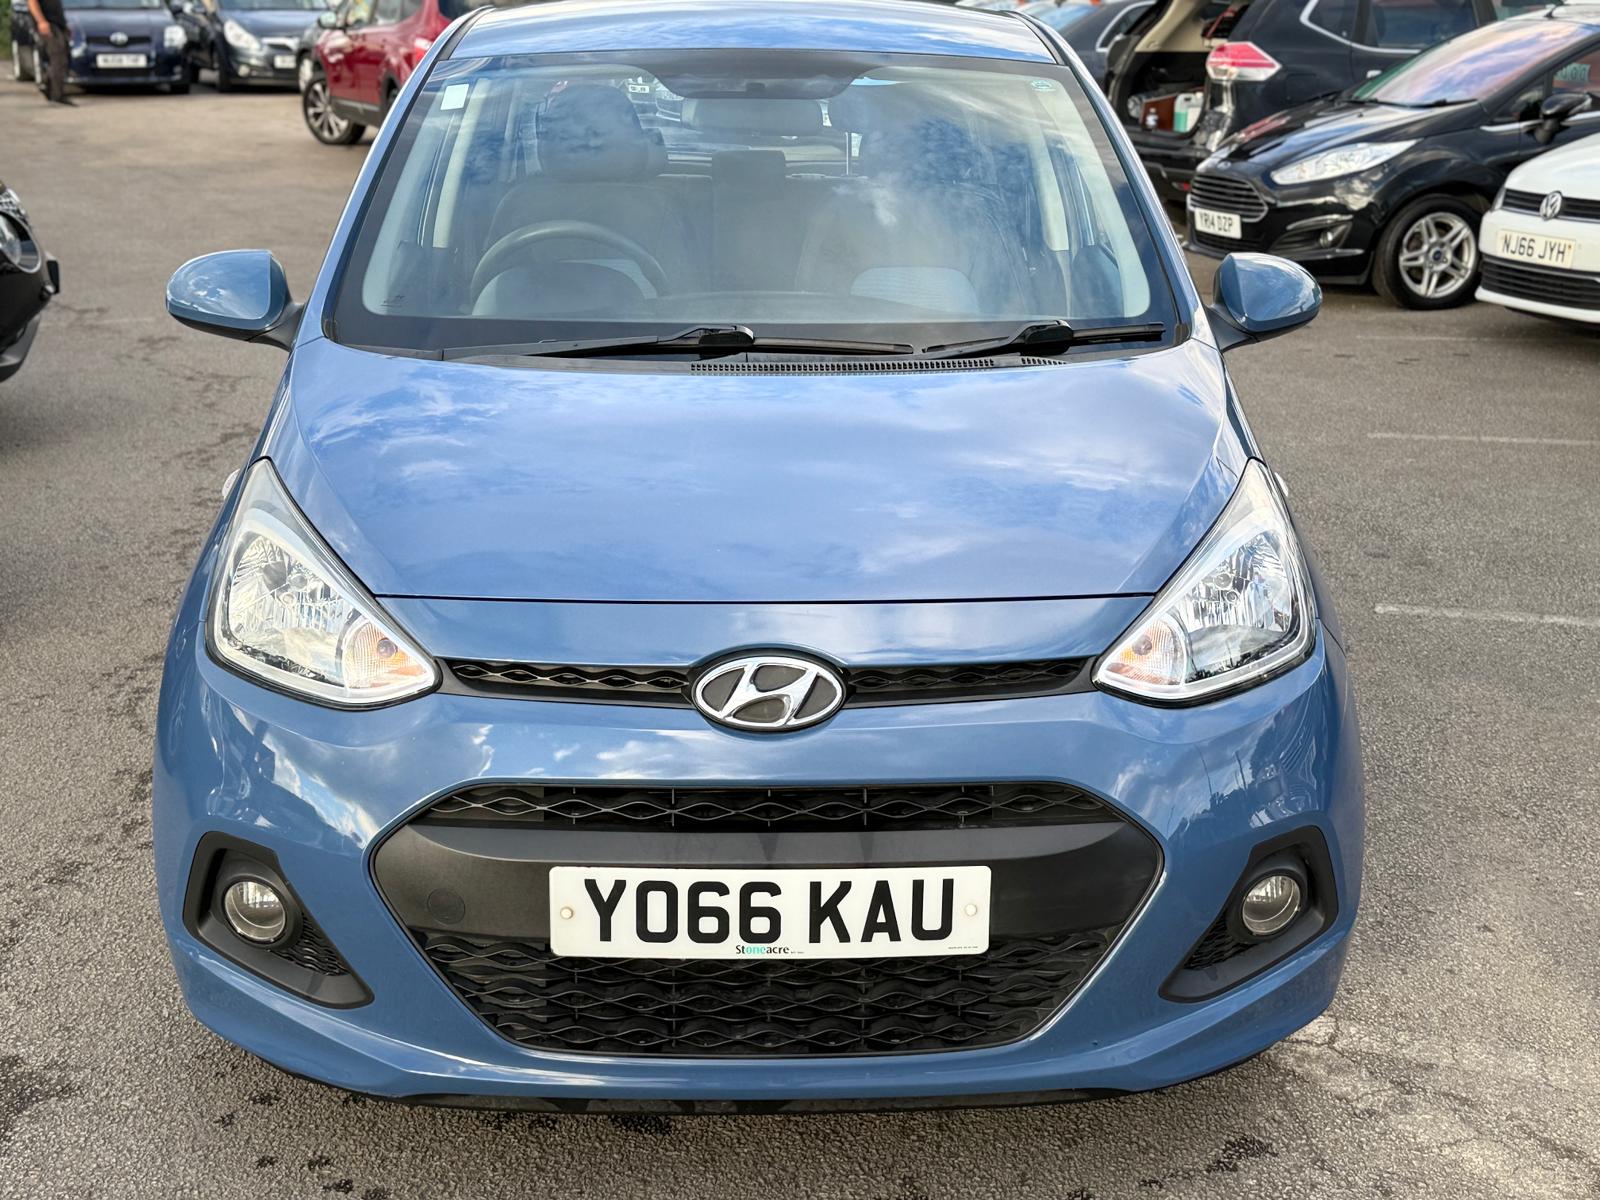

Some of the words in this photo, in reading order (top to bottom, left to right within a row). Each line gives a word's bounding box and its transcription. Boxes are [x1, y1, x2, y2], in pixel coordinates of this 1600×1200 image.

[1502, 234, 1536, 258] NJ66
[1538, 240, 1567, 263] JYH
[584, 878, 782, 944] YO66
[808, 878, 954, 944] KAU
[735, 944, 790, 955] Stoneacre
